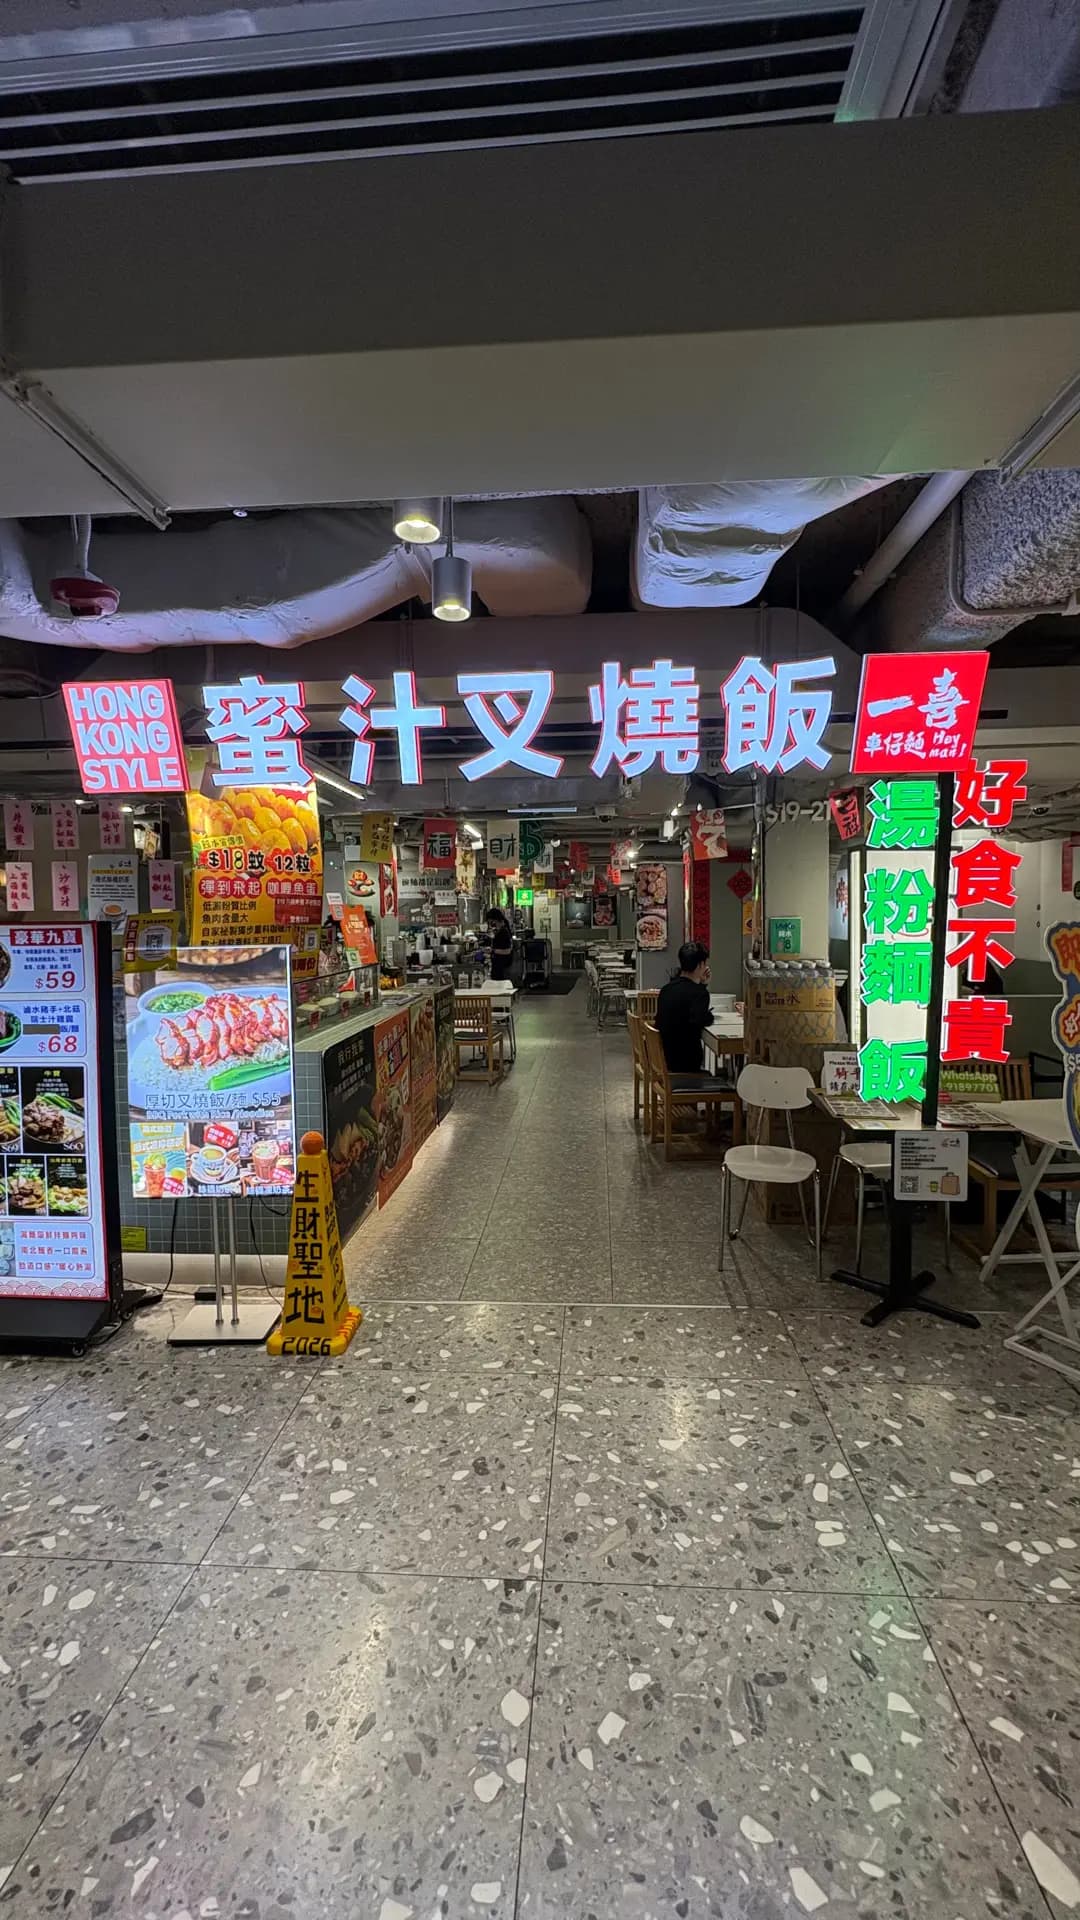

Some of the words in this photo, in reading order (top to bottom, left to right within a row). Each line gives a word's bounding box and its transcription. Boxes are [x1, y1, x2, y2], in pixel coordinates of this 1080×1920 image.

[69, 684, 166, 721] HONG
[867, 668, 970, 729] 一喜
[79, 720, 171, 756] KONG
[202, 656, 836, 787] 蜜汁叉燒飯
[929, 743, 967, 758] man!
[83, 757, 181, 790] STYLE
[274, 854, 310, 872] 12粒
[940, 758, 1029, 1064] 好食不貴
[858, 780, 940, 1104] 湯粉麵飯
[35, 971, 76, 989] $59
[38, 1035, 77, 1053] $68
[941, 1070, 998, 1082] WhatsApp
[145, 1093, 248, 1109] 厚切叉燒飯/麵
[252, 1092, 281, 1108] $55
[285, 1170, 325, 1324] 生財聖地
[281, 1336, 332, 1356] 2026
